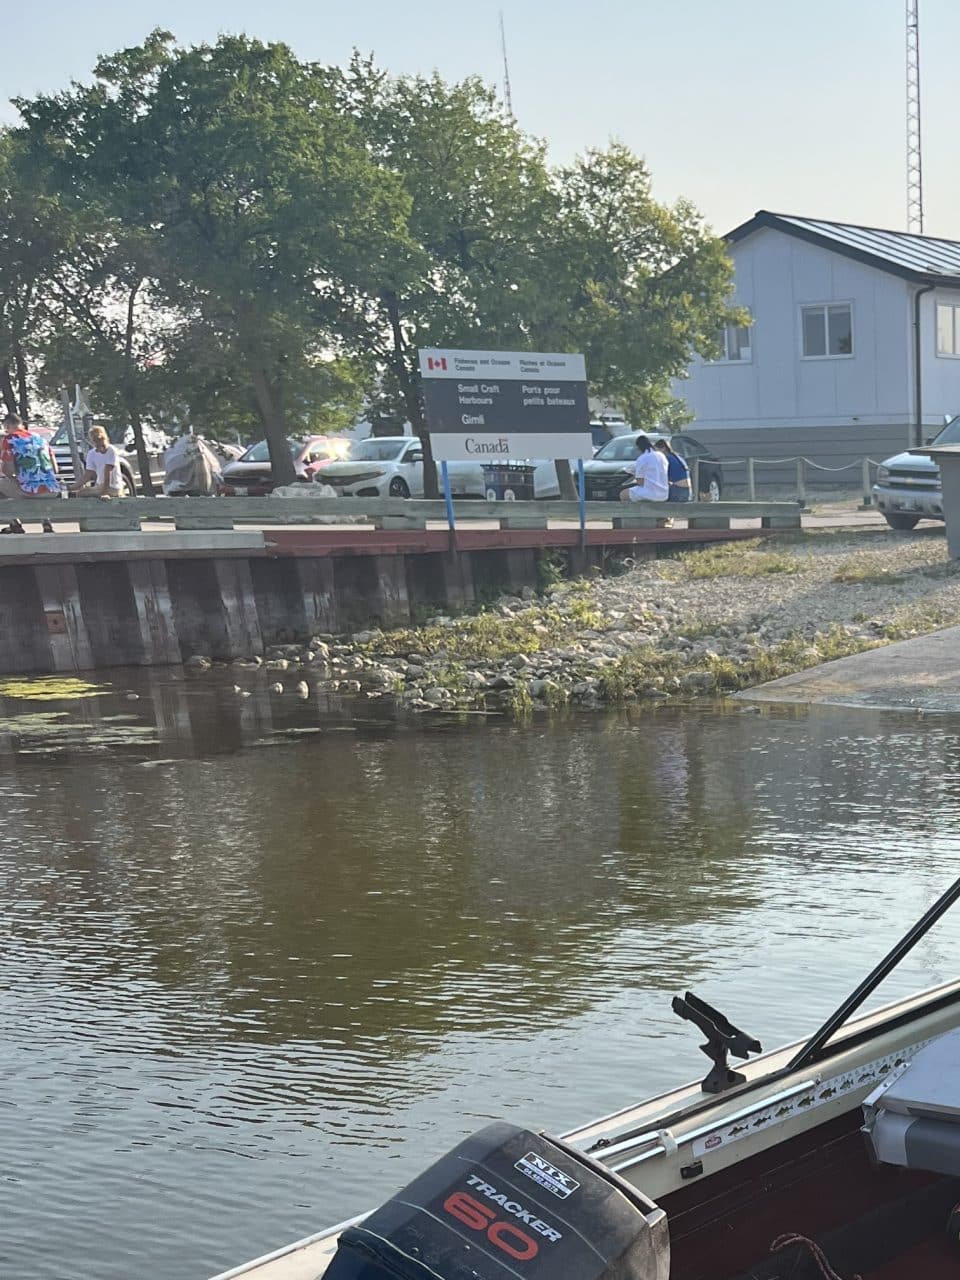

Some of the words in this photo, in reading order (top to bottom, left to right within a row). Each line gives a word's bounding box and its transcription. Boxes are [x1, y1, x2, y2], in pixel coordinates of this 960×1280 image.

[458, 384, 478, 393] Small
[480, 384, 500, 393] Craft
[521, 385, 541, 394] Ports
[543, 386, 561, 395] pour
[459, 395, 493, 405] Harbours
[523, 397, 545, 406] petits
[546, 397, 576, 406] bateaux
[461, 414, 485, 424] Gimli
[464, 437, 509, 454] Canada
[531, 1157, 571, 1187] NIX
[466, 1174, 562, 1242] TRACKER
[443, 1191, 539, 1261] 60
